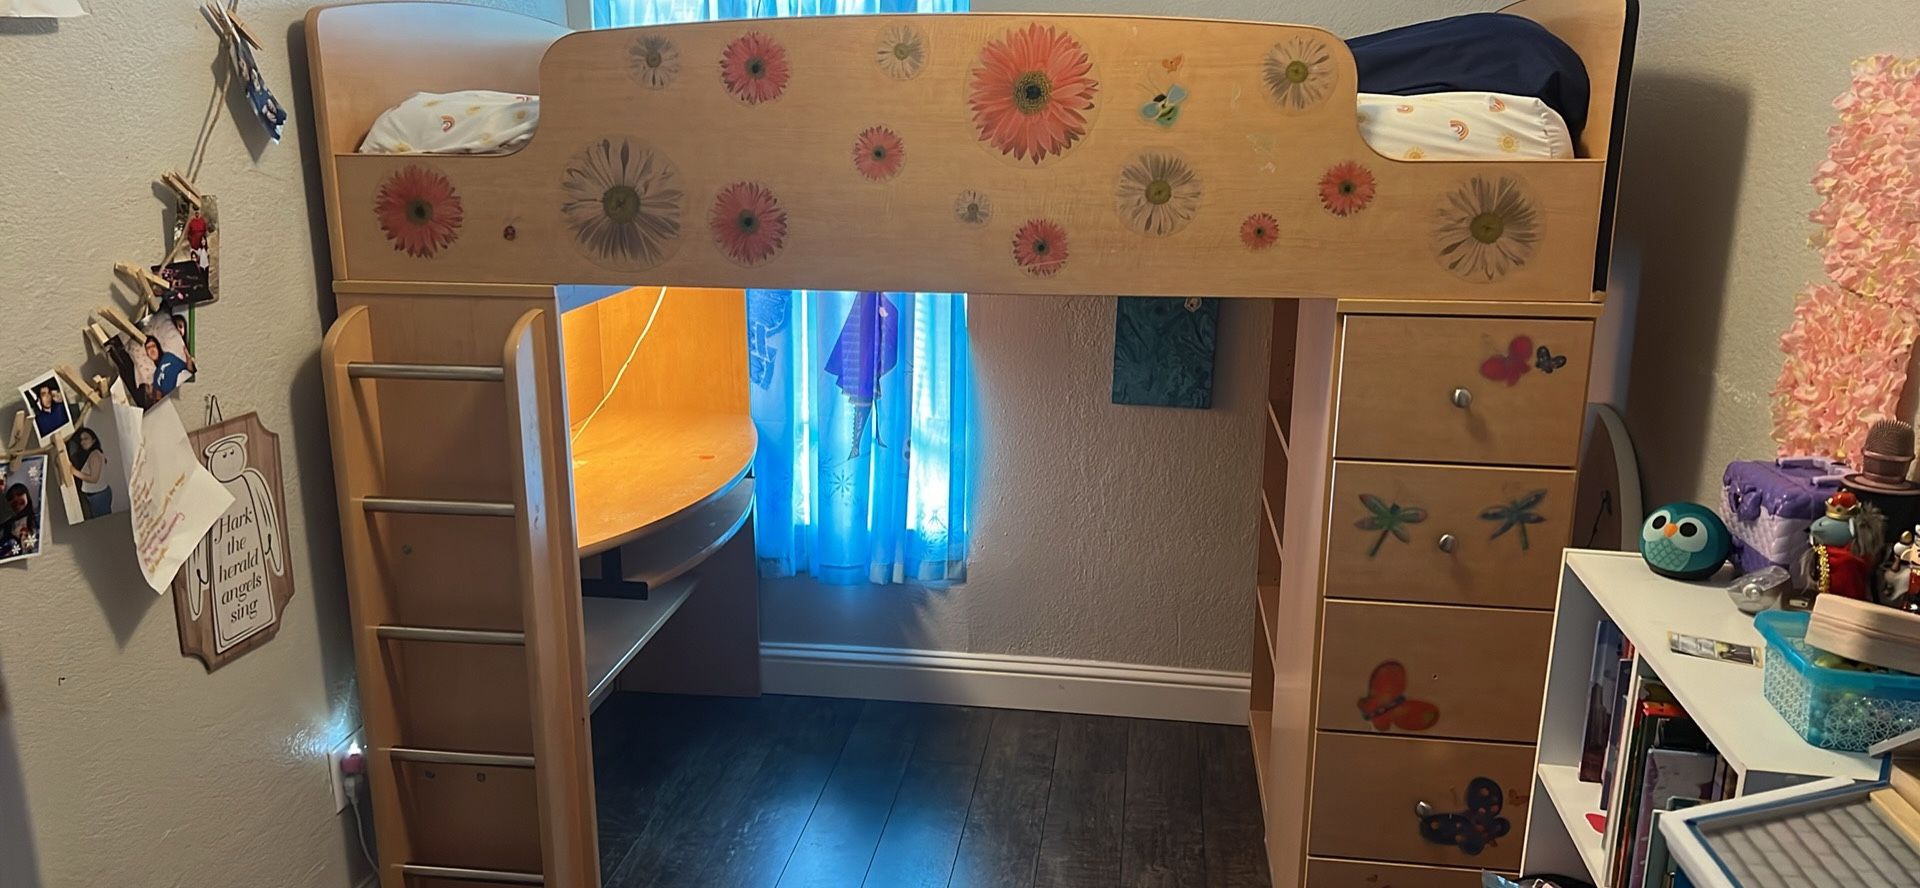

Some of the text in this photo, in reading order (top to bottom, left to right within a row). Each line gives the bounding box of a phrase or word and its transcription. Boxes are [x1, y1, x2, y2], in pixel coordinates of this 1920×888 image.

[214, 507, 252, 544] Hark
[227, 535, 246, 556] the
[219, 548, 259, 583] herald
[221, 572, 262, 605] angels
[230, 599, 258, 623] sing
